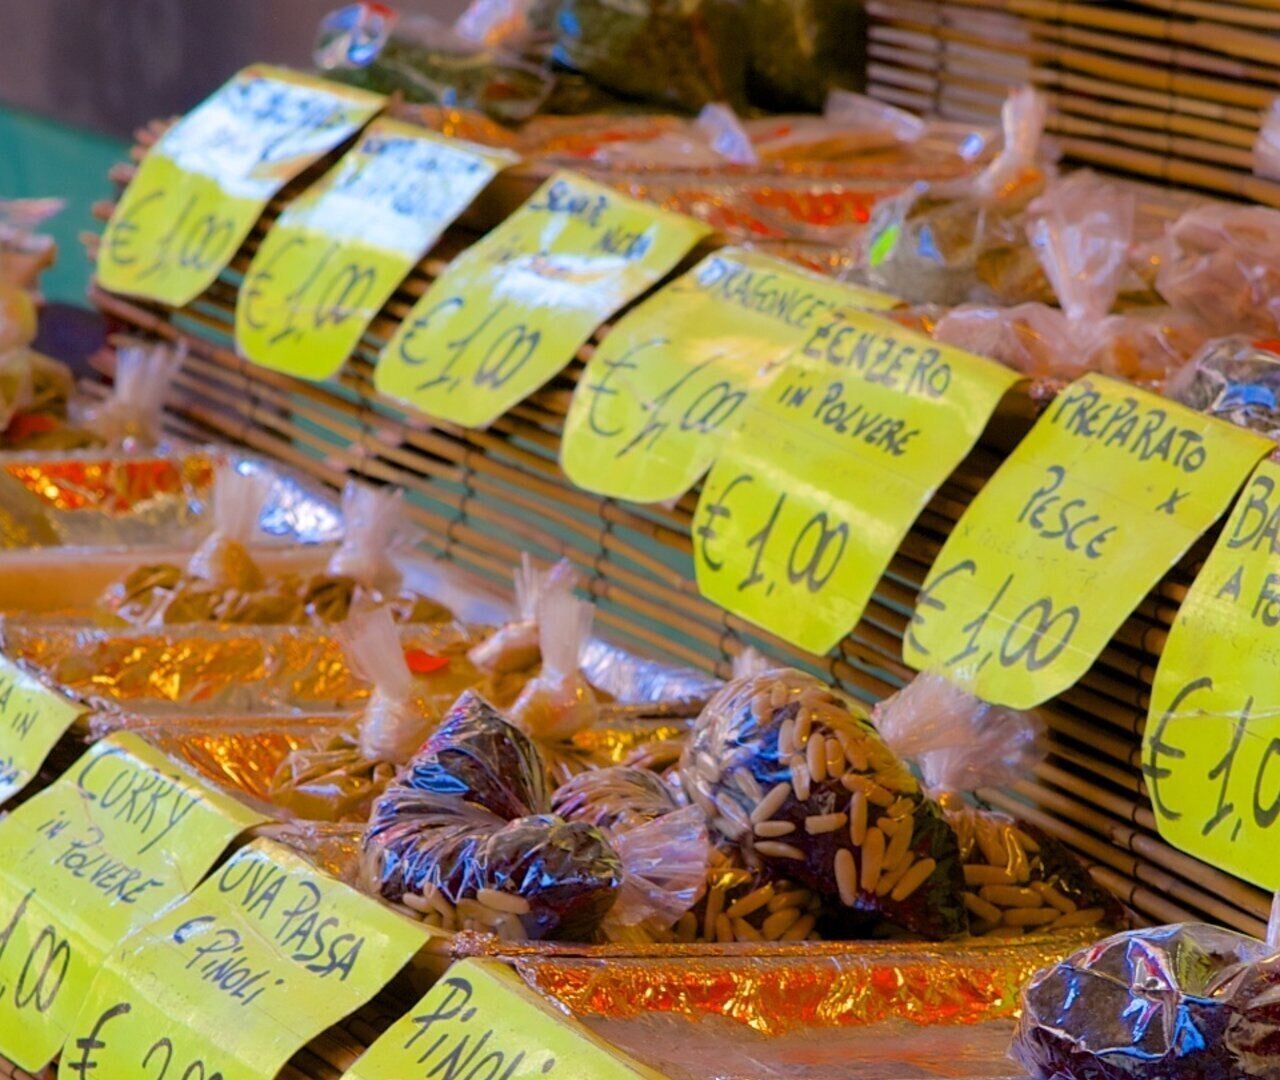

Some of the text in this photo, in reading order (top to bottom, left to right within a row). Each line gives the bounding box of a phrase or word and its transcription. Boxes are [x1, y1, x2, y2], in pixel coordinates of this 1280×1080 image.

[803, 307, 953, 400] ZENZERO
[810, 396, 923, 458] POLVERE
[1049, 384, 1208, 473] PREPARATO
[1018, 465, 1117, 560] PESCE
[1216, 567, 1247, 602] A
[57, 825, 165, 906] POLVERE
[217, 850, 367, 982] UVA PASSA
